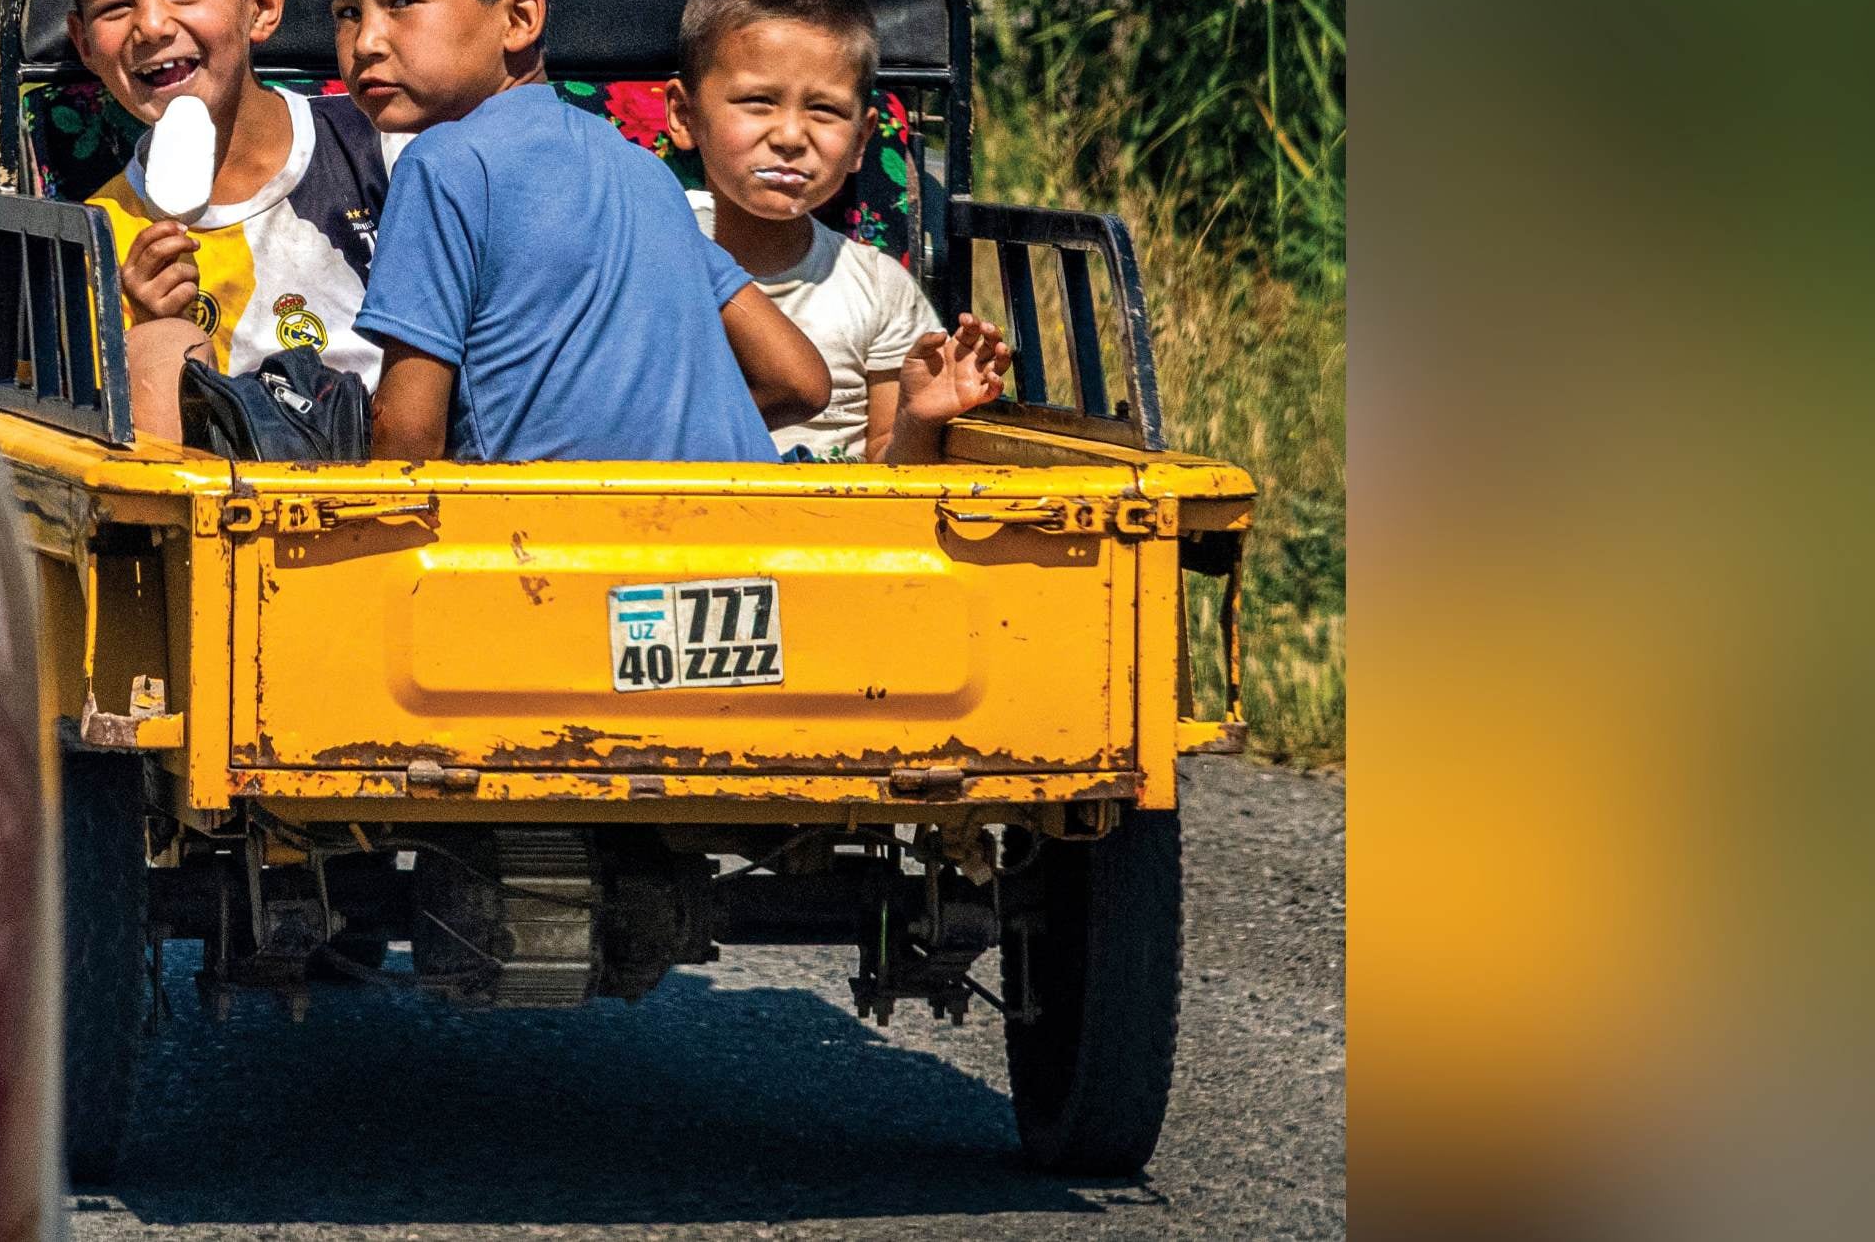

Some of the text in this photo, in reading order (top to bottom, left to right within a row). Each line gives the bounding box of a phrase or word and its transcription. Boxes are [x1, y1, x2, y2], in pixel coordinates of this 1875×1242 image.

[628, 623, 656, 641] UZ
[680, 585, 773, 643] 777
[618, 644, 674, 685] 40
[684, 644, 780, 680] ZZZZ
